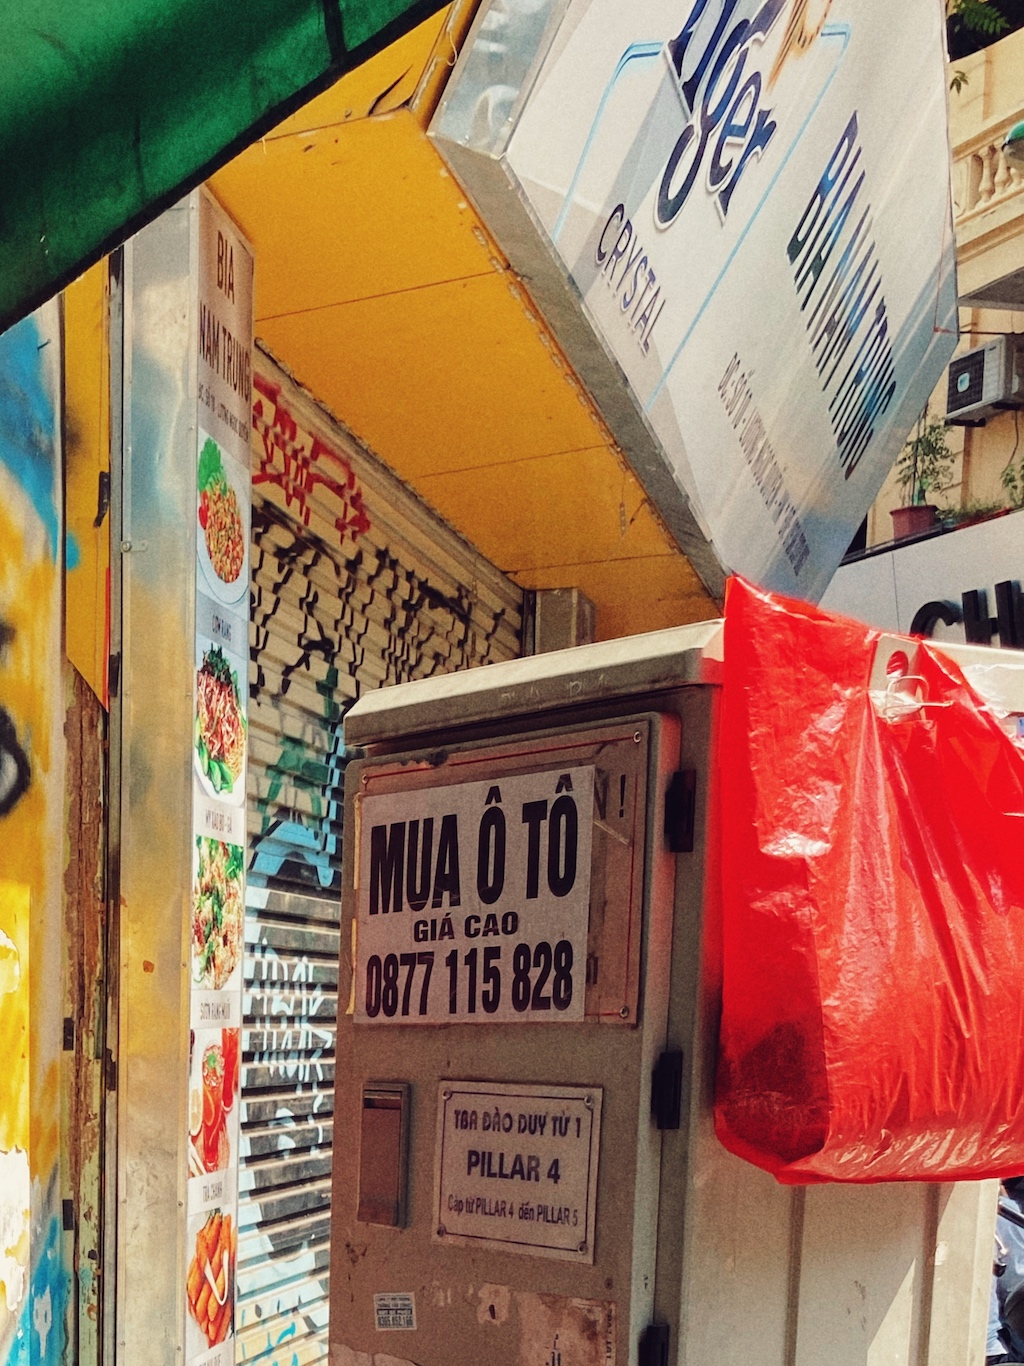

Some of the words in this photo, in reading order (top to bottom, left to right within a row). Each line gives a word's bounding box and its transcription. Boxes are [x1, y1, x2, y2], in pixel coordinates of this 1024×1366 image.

[656, 0, 784, 224] iger
[786, 109, 866, 312] BIA
[217, 229, 235, 305] BIA
[597, 203, 666, 357] CRYSTAL
[805, 203, 882, 392] NAM
[199, 300, 220, 374] NAM
[222, 325, 251, 403] TRUNG
[828, 295, 897, 481] TRUNG
[369, 813, 461, 916] MUA
[476, 785, 507, 905] Ô
[521, 773, 579, 900] TÔ
[413, 912, 456, 943] GIÁ
[464, 911, 519, 939] CAO
[365, 950, 435, 1018] 0877
[445, 945, 502, 1014] 115
[511, 939, 574, 1013] 828
[482, 1106, 513, 1133] ĐÀO
[466, 1149, 540, 1182] PILLAR
[547, 1158, 561, 1184] 4
[476, 1197, 507, 1218] PILLAR
[508, 1202, 514, 1219] 4
[536, 1204, 570, 1226] PILLAR
[572, 1208, 579, 1227] 5
